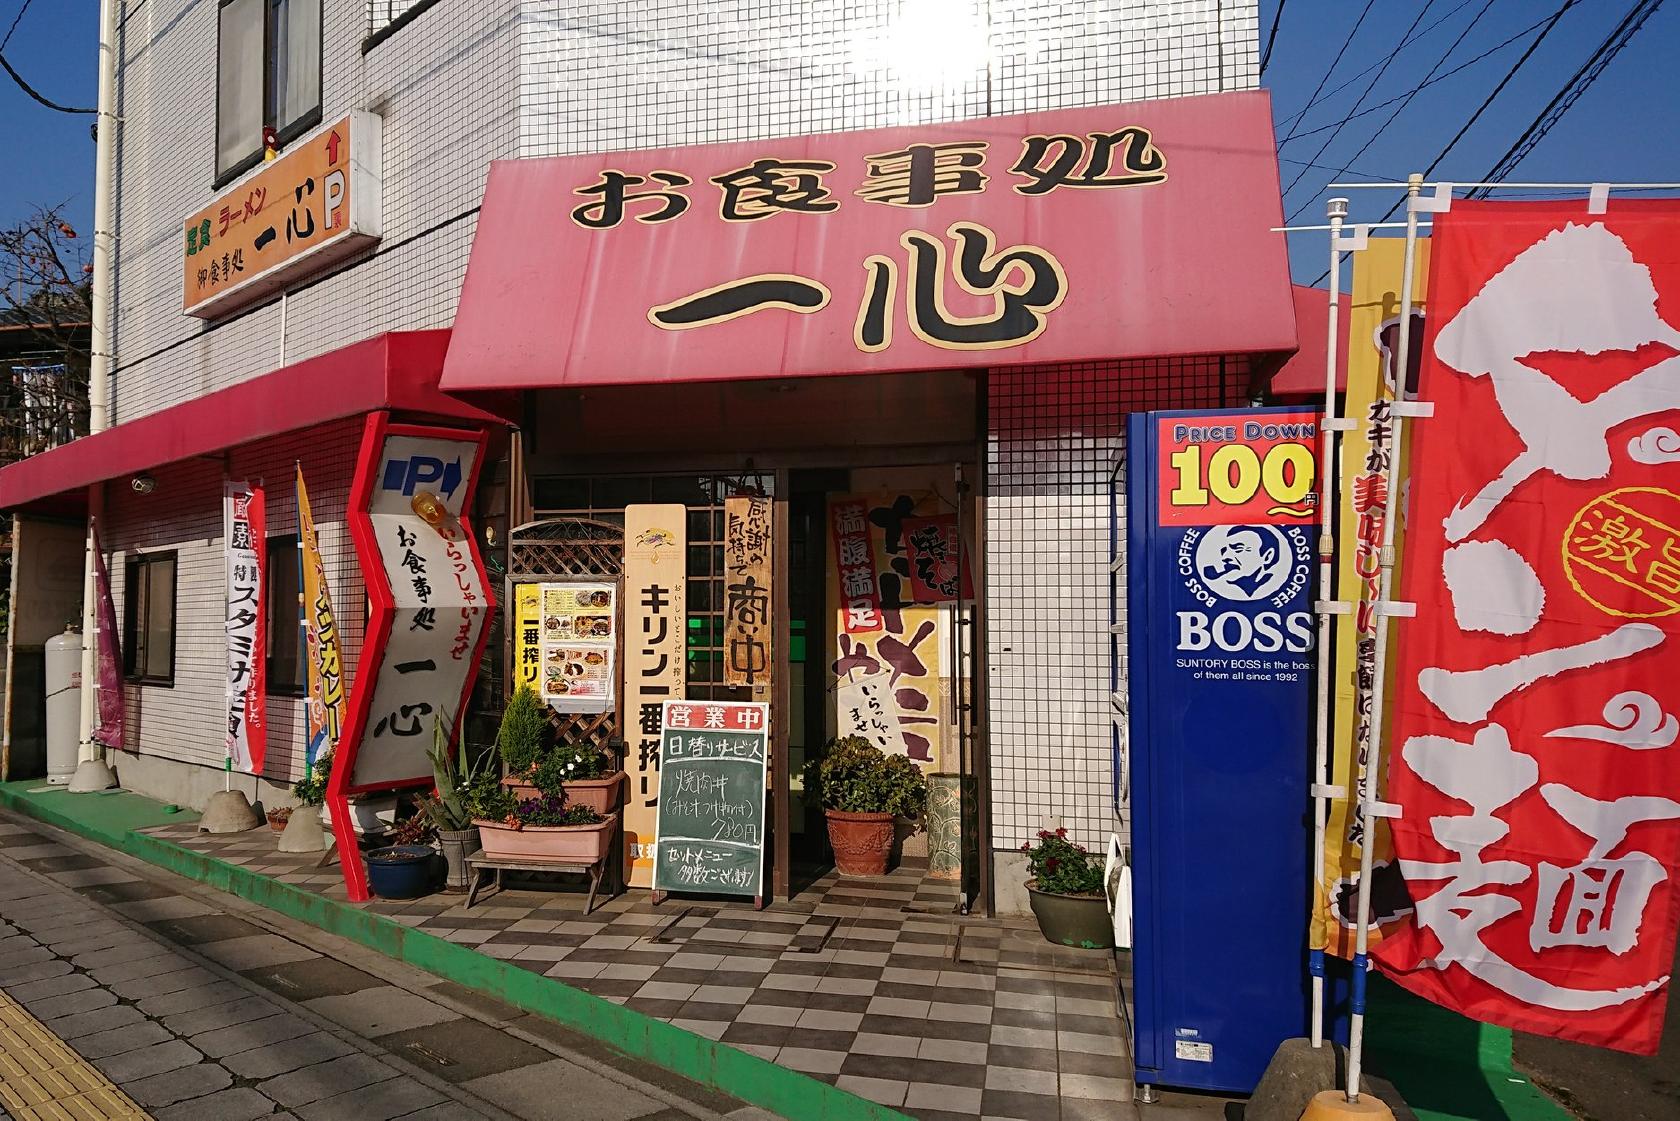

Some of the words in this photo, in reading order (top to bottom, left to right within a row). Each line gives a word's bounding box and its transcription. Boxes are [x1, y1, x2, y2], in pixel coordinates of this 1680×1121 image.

[324, 169, 345, 230] P
[570, 126, 1168, 230] お食事処
[186, 218, 211, 257] 定食
[219, 187, 267, 238] ラーメン
[254, 177, 315, 251] 一心
[197, 247, 244, 290] 御食事処
[646, 221, 1069, 352] 一心
[745, 500, 771, 567] 感謝の
[1178, 526, 1201, 576] COFFEE
[1287, 526, 1311, 562] BOSS
[397, 525, 435, 631] お食事処
[835, 504, 879, 631] 満腹満足
[1185, 577, 1217, 608] BOSS
[1270, 563, 1310, 608] COFFEE
[437, 527, 479, 660] いらっしゃいませ
[1176, 611, 1315, 653] BOSS
[1176, 658, 1228, 669] SUNTORY
[1231, 659, 1261, 669] BOSS
[1263, 659, 1272, 669] is
[1274, 660, 1290, 670] the
[1292, 660, 1316, 670] boss
[1194, 670, 1203, 679] of
[1205, 671, 1229, 680] them
[1232, 671, 1244, 680] all
[1246, 672, 1271, 681] since
[1275, 672, 1298, 681] 1992
[374, 659, 437, 738] 一心
[670, 705, 761, 729] 営業中
[667, 846, 733, 864] セットメニュー
